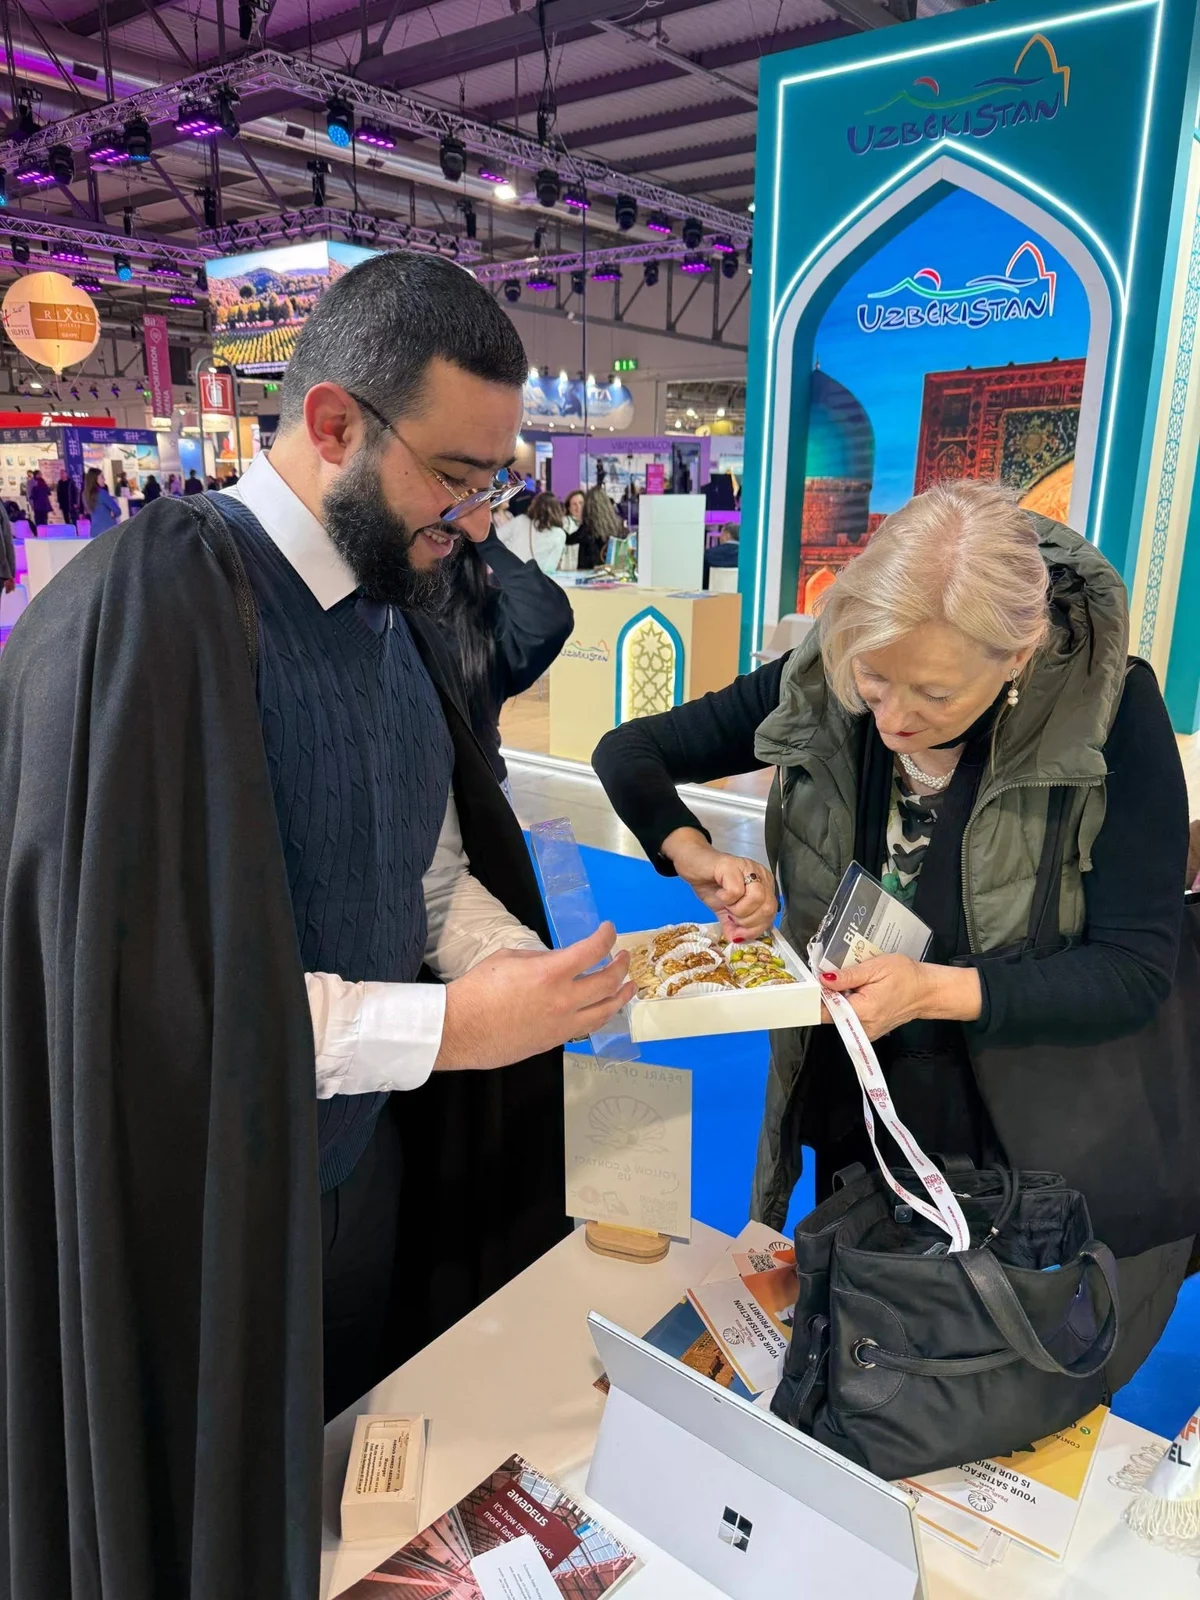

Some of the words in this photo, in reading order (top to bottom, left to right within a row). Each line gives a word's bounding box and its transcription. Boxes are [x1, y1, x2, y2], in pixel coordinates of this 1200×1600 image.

[847, 93, 1060, 156] UZBEKISTAN
[44, 307, 91, 322] RIXOS
[857, 293, 1048, 333] UZBEKISTAN
[150, 346, 163, 417] TRANSPORTATION
[733, 1298, 766, 1342] SATISFACTION
[747, 1300, 771, 1329] PRIORITY
[767, 1327, 780, 1342] OUR
[762, 1340, 779, 1358] YOUR
[777, 1341, 786, 1349] IS
[955, 1462, 1008, 1490] SATISFACT
[997, 1468, 1019, 1482] OUR
[1020, 1478, 1031, 1488] IS
[1009, 1486, 1038, 1504] YOUR
[482, 1510, 502, 1528] more
[492, 1500, 505, 1513] It's
[501, 1509, 518, 1526] how
[532, 1538, 555, 1560] works
